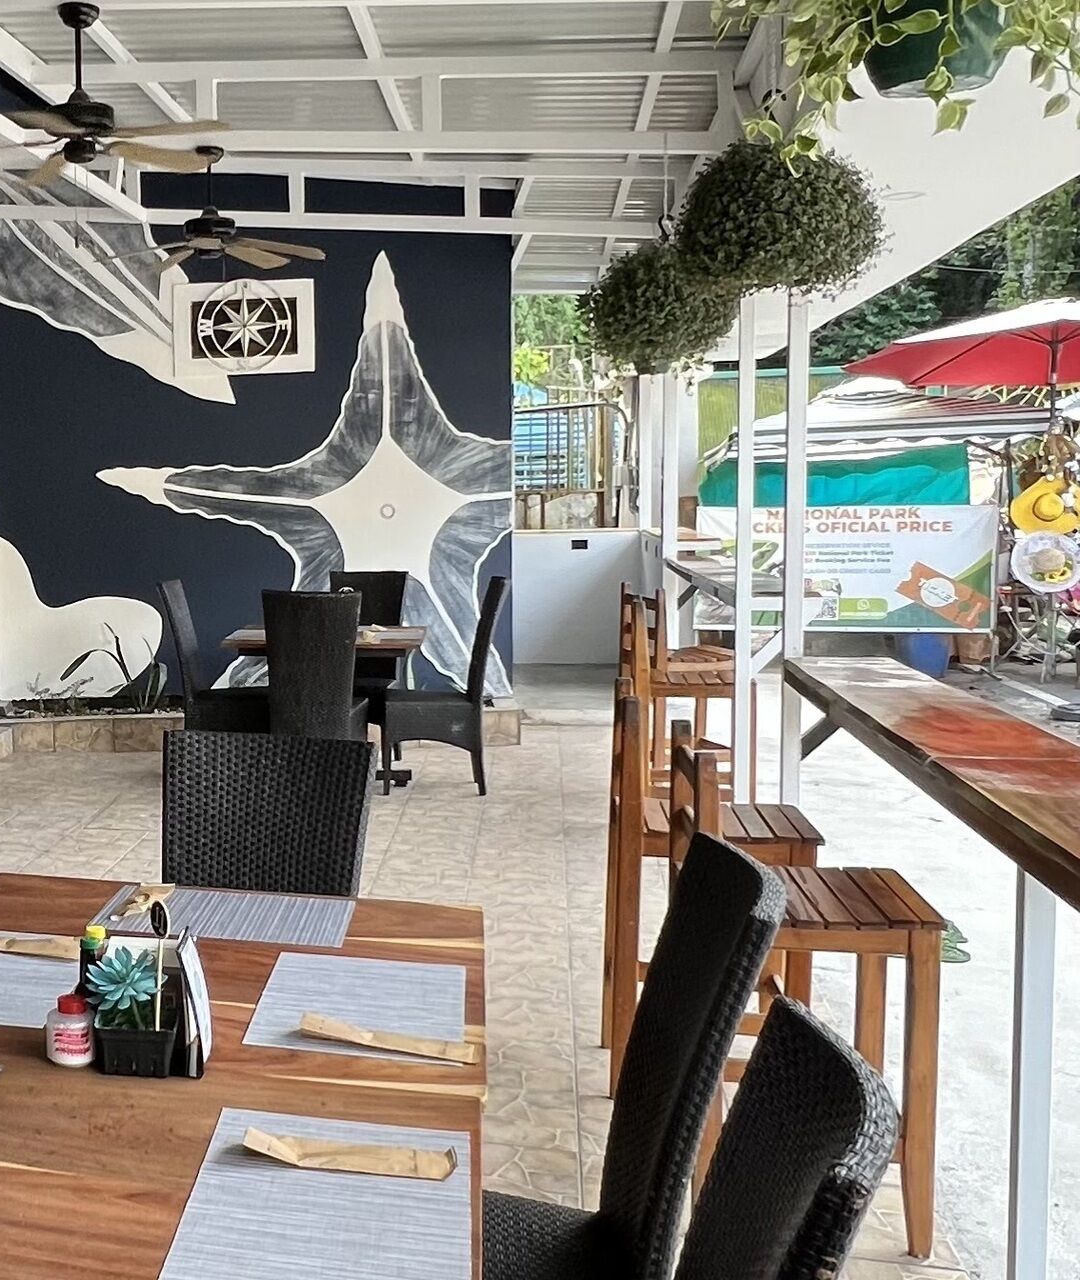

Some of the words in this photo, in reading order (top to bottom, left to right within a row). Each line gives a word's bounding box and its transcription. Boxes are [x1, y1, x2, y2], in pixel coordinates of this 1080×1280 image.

[767, 508, 862, 521] NIONAL
[869, 508, 921, 519] PARK
[752, 522, 811, 533] CKES
[816, 521, 890, 533] OFICIAL
[897, 521, 953, 532] PRICE
